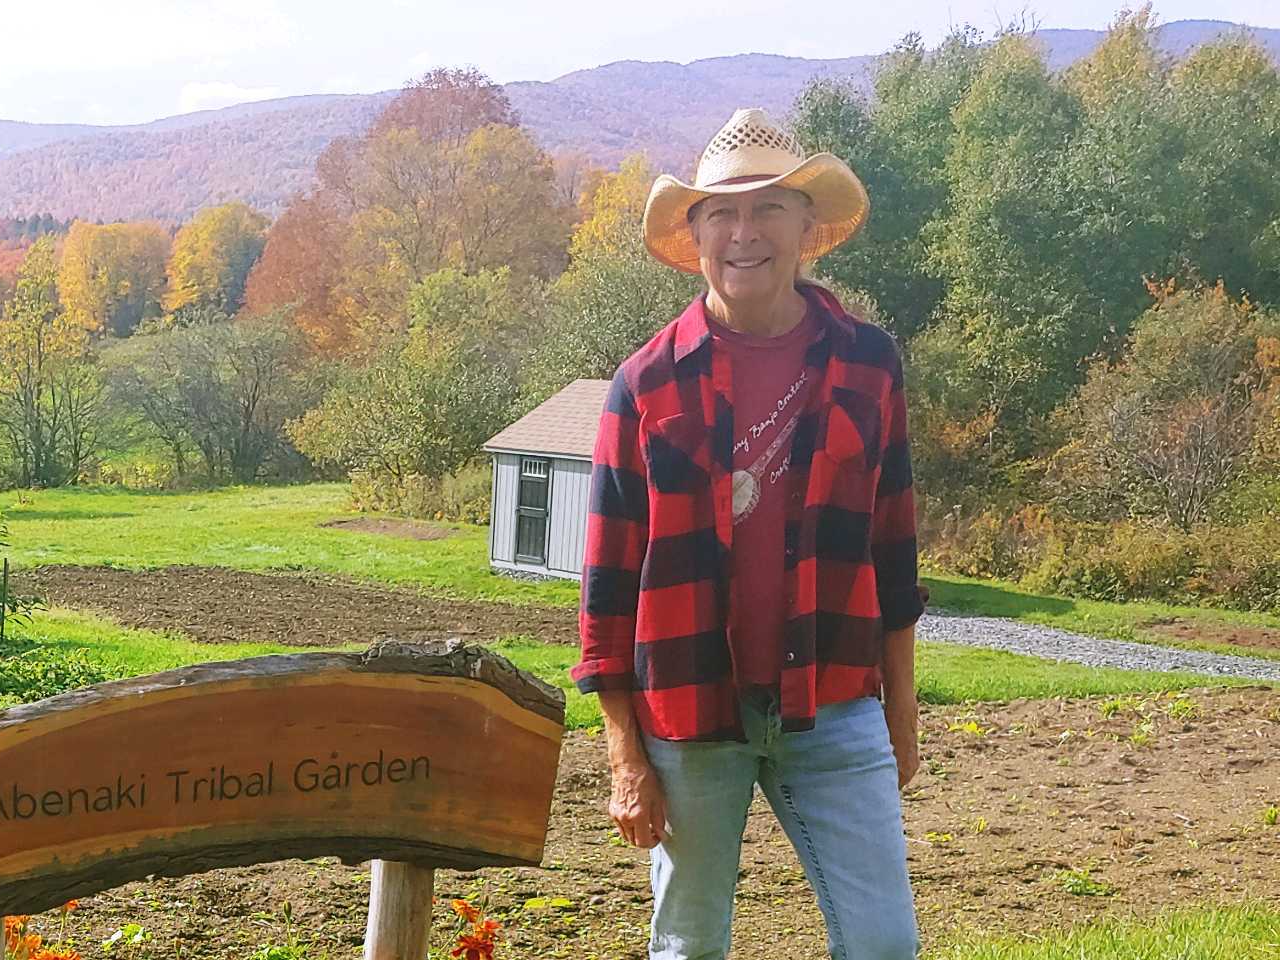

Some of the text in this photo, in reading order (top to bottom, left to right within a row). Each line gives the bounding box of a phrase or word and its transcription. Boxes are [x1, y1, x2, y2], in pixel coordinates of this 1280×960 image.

[749, 411, 778, 438] Banjo
[777, 369, 808, 411] Contest
[166, 760, 274, 804] Tribal
[293, 750, 431, 793] Garden
